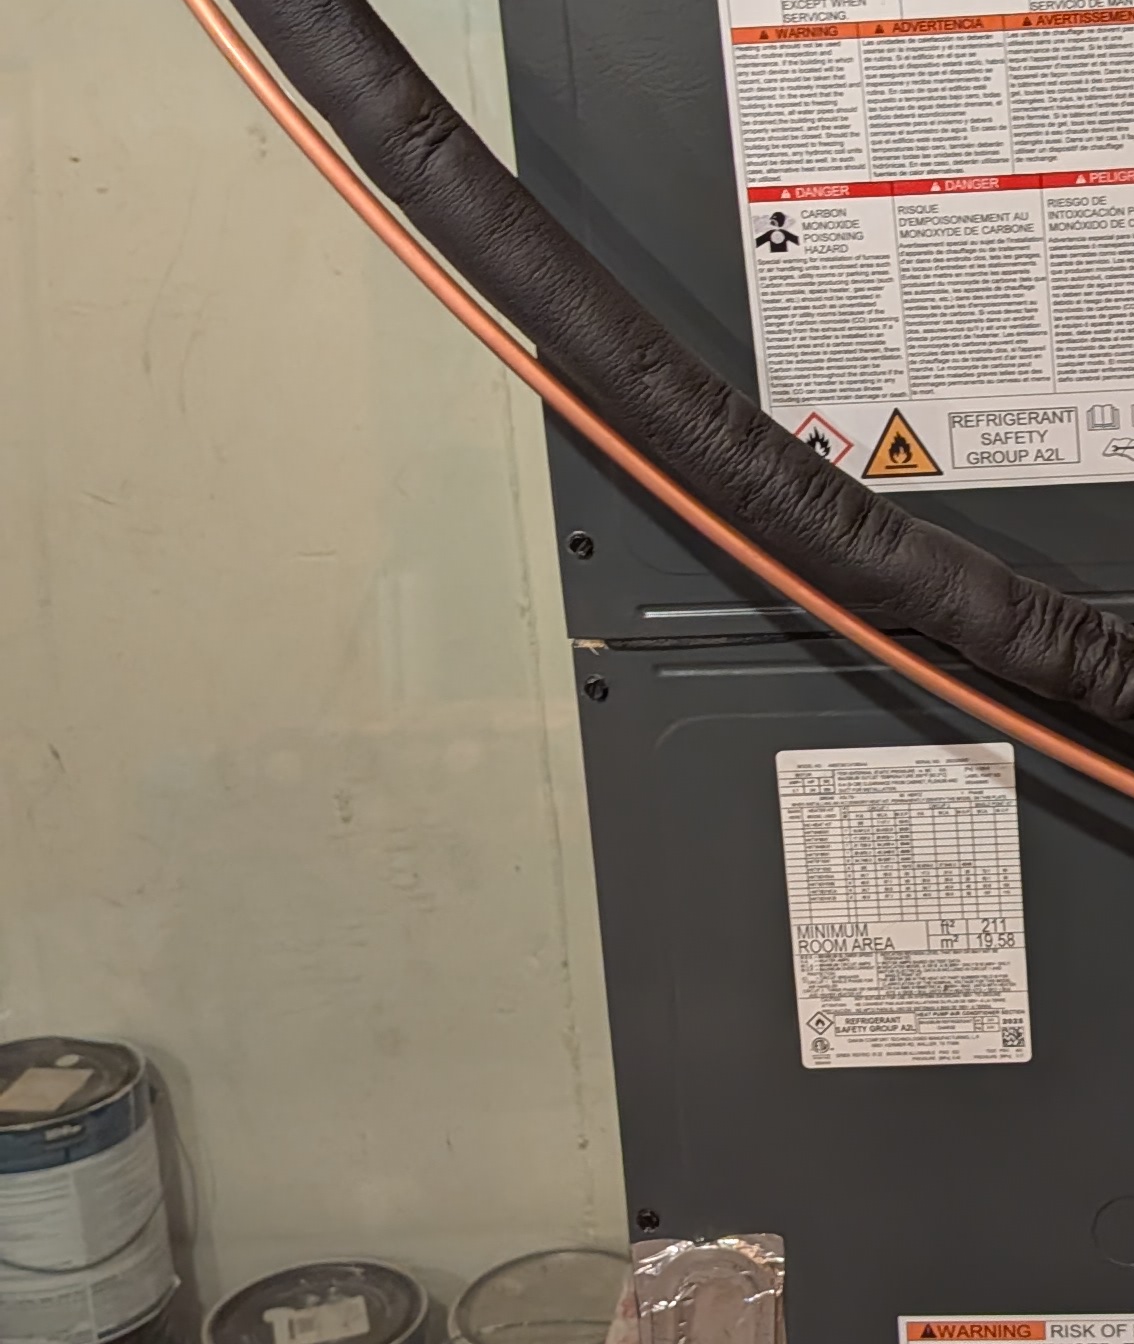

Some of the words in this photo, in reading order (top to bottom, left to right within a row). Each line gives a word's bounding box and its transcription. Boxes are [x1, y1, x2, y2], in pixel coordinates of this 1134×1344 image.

[783, 11, 848, 22] SERVICING.
[775, 26, 839, 37] WARNING
[891, 19, 984, 33] ADVERTENCIA
[795, 185, 850, 197] DANGER
[945, 178, 1000, 190] DANGER
[800, 208, 847, 218] CARBON
[802, 219, 861, 230] MONOXIDE
[803, 231, 865, 241] POISONING
[804, 244, 849, 253] HAZARD
[951, 410, 1075, 427] REFRIGERANT
[980, 429, 1049, 445] SAFETY
[966, 449, 1029, 464] GROUP
[1033, 448, 1067, 462] A2L
[796, 923, 869, 939] MINIMUM
[981, 918, 1008, 932] 211
[798, 938, 847, 952] ROOM
[851, 937, 895, 951] AREA
[975, 933, 1016, 947] 19.58
[938, 1325, 1032, 1338] WARNING
[1050, 1324, 1095, 1338] RISK
[1100, 1324, 1127, 1337] OF
